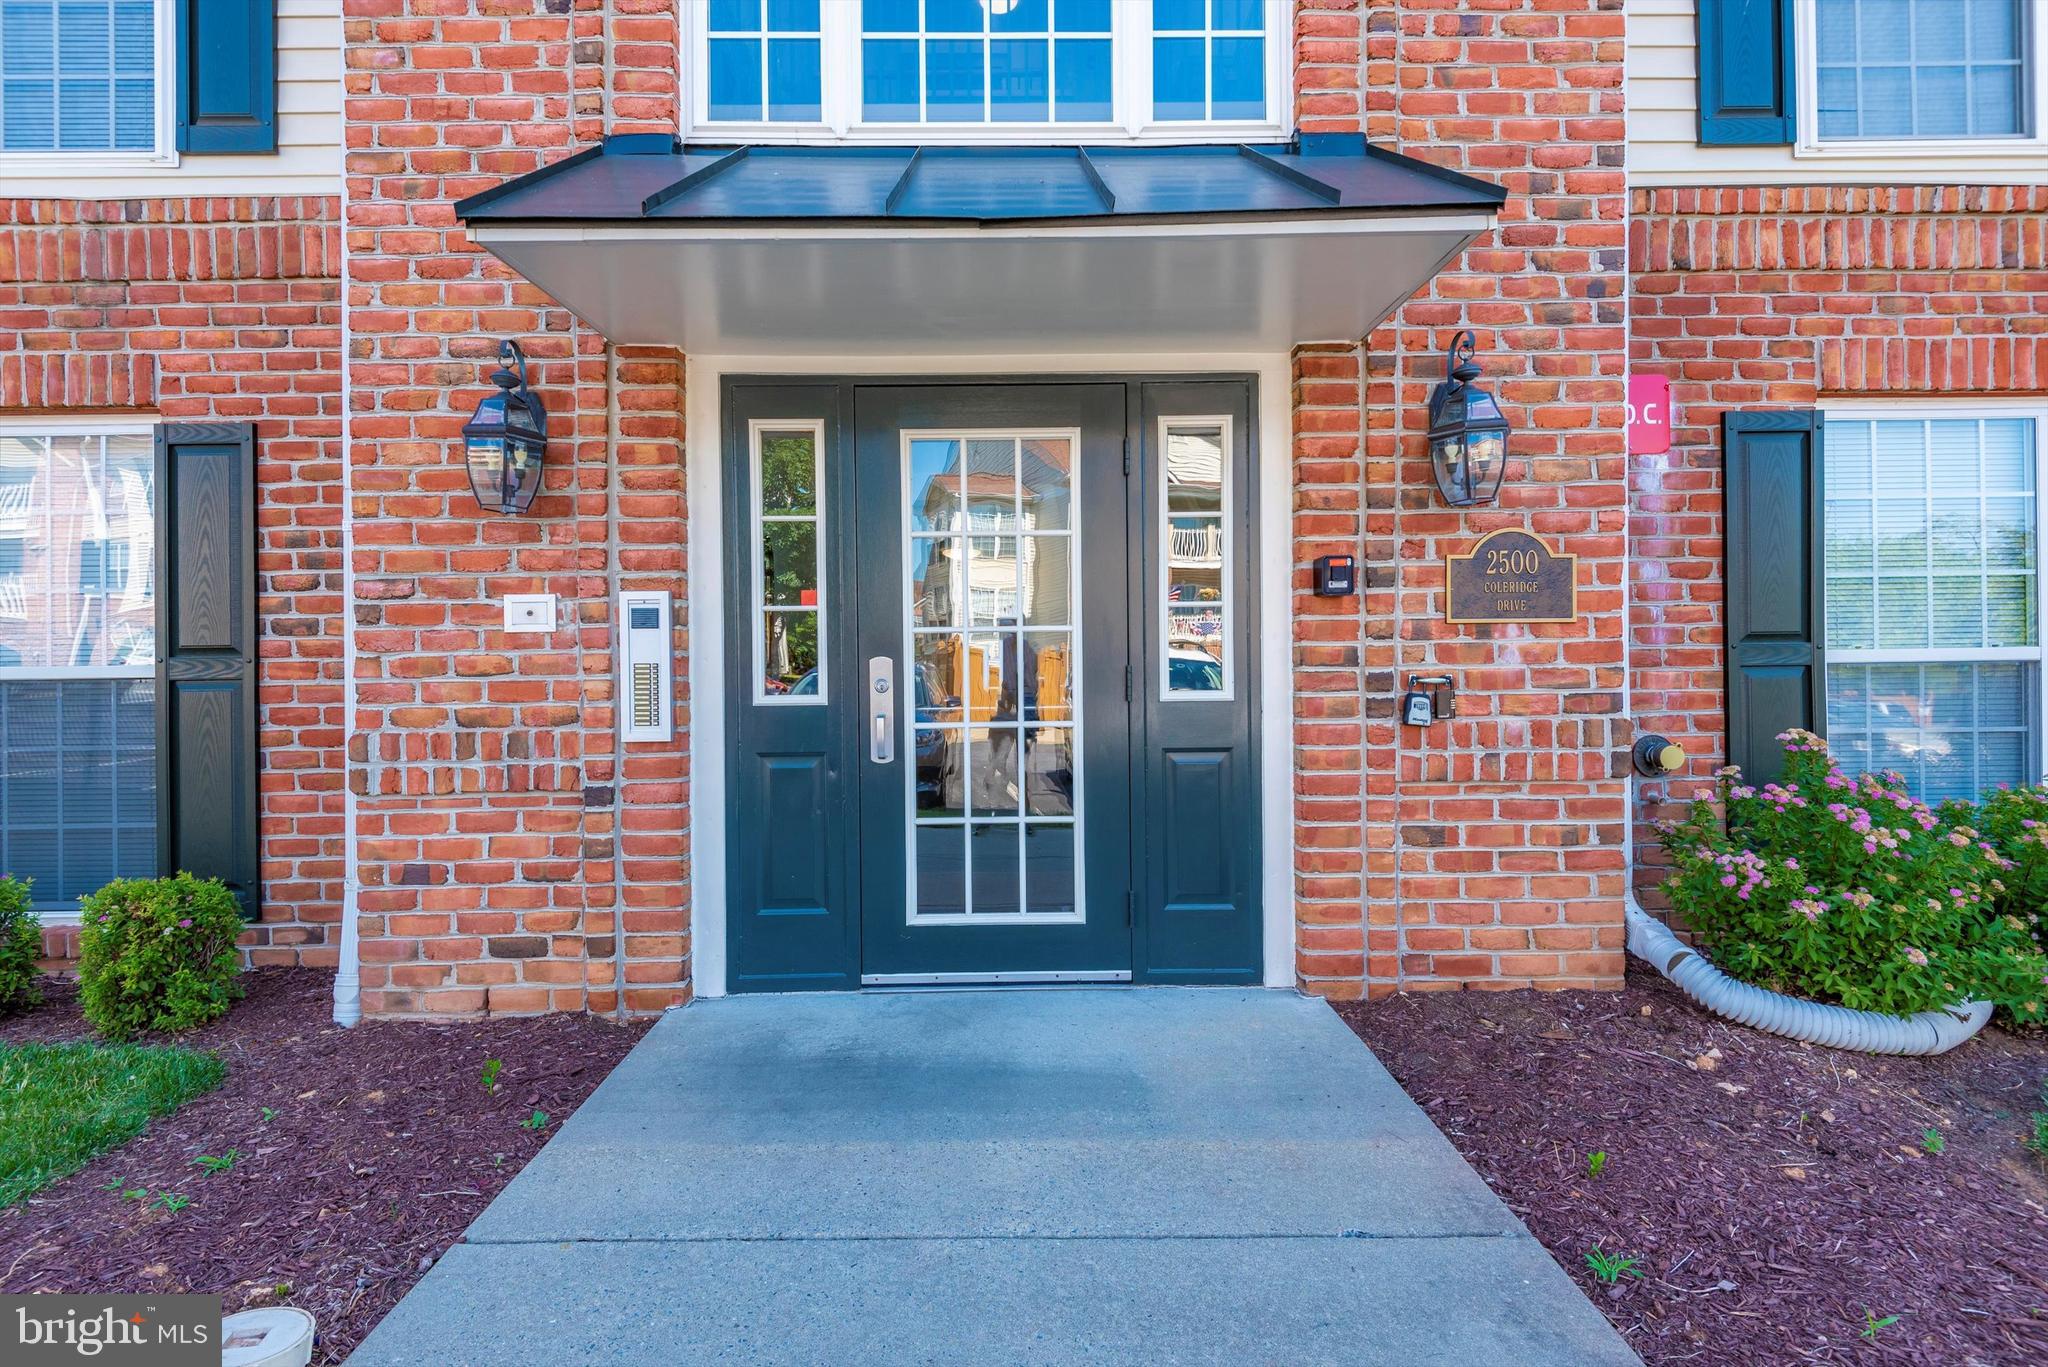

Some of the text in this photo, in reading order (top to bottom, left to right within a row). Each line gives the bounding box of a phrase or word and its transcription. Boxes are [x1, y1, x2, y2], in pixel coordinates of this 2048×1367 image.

[1486, 549, 1539, 575] 2500
[1484, 581, 1539, 593] COLERIDGE
[1497, 599, 1527, 611] DRIVE
